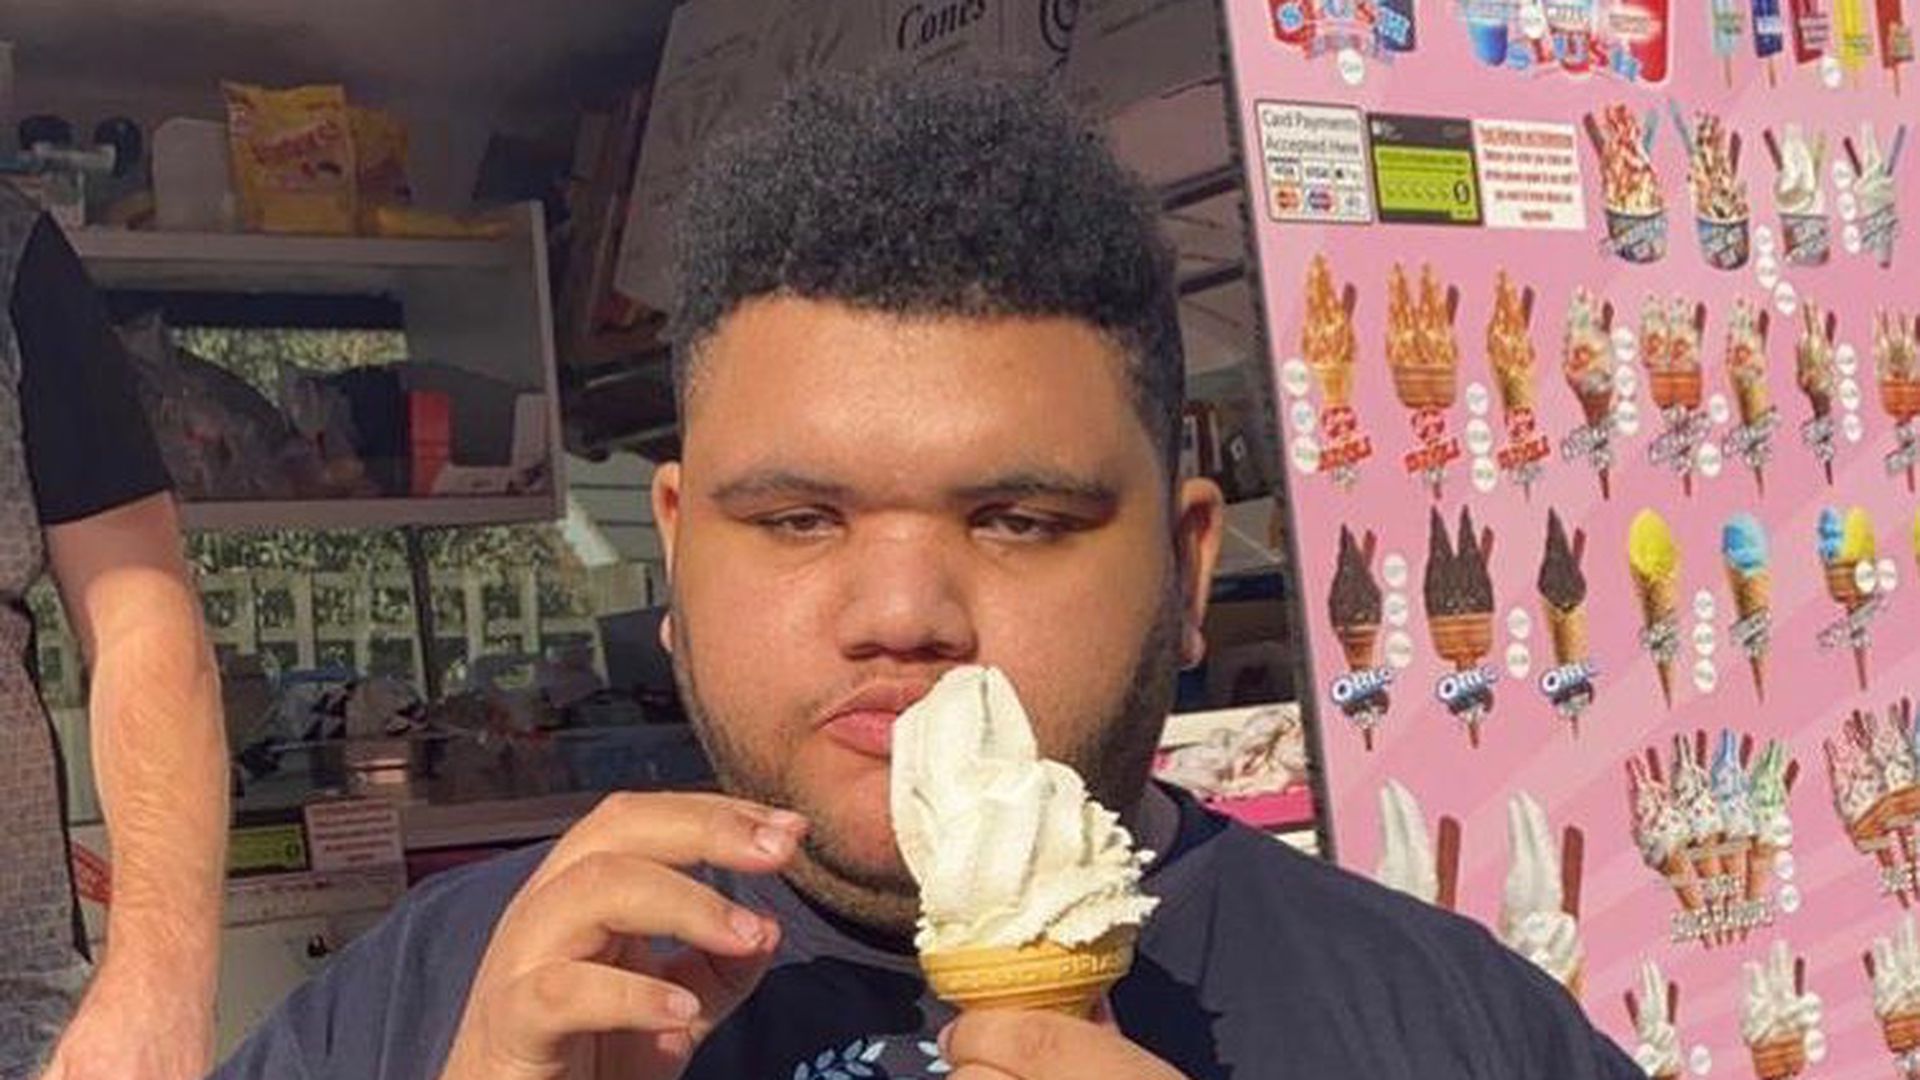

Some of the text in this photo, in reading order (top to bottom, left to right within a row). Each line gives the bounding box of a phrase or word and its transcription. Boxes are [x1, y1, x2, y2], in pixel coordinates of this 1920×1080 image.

[896, 0, 987, 51] Cones
[1262, 109, 1293, 128] Card
[1296, 111, 1359, 131] Payments
[1265, 136, 1360, 154] Accepted Here
